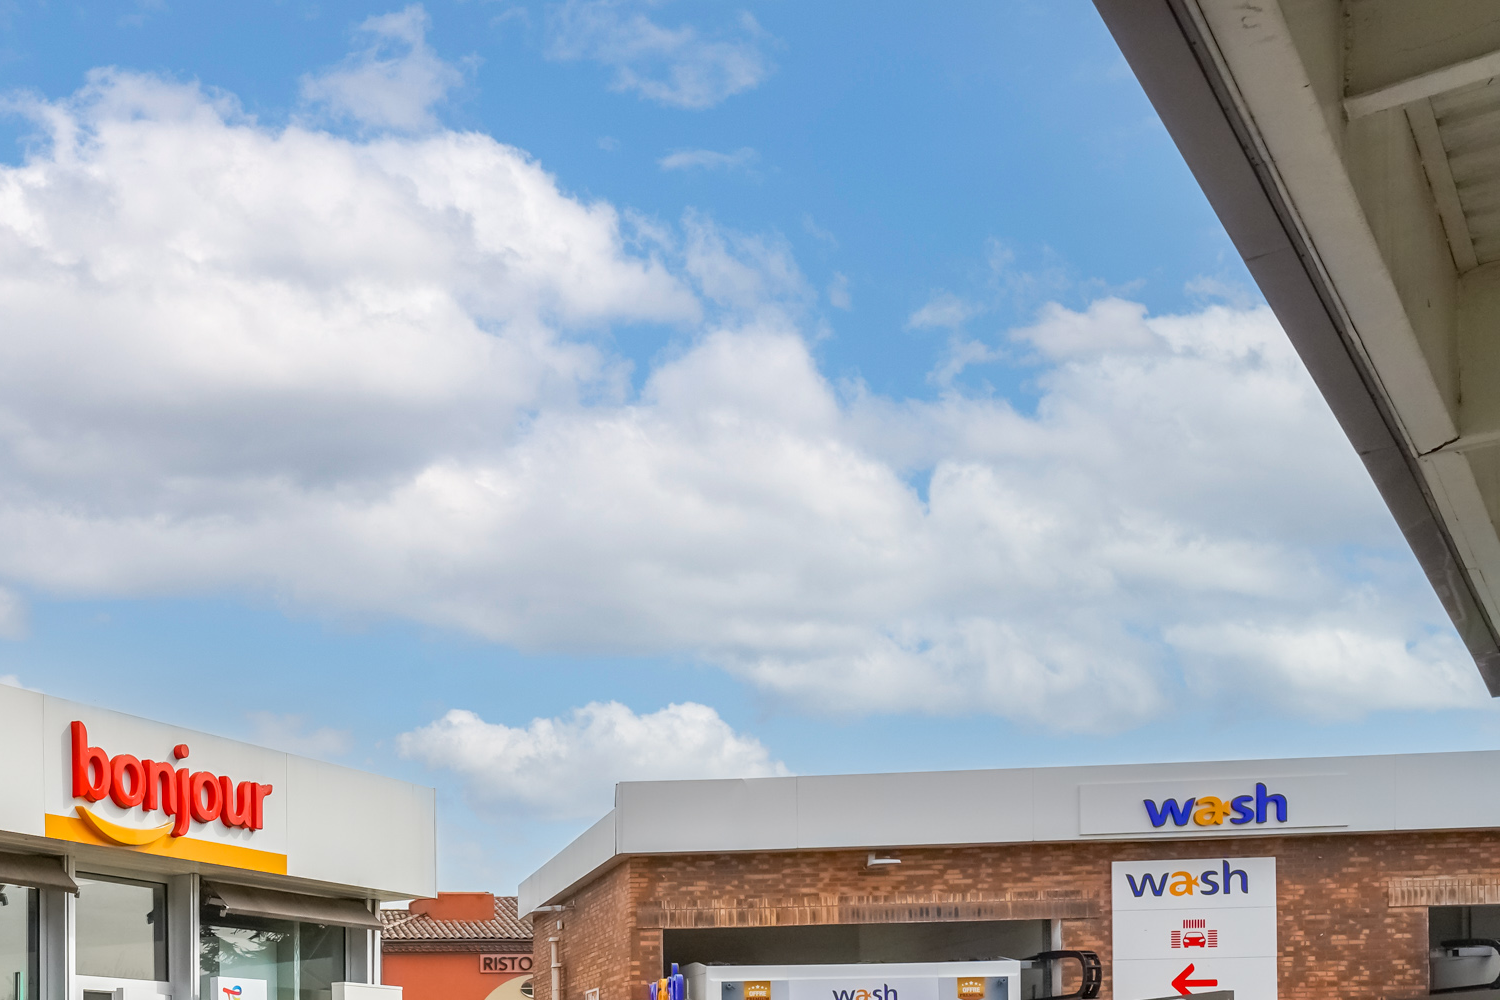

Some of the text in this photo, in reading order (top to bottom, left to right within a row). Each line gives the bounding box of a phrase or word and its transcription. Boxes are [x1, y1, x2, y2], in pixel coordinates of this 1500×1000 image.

[71, 720, 273, 838] bonjour
[1143, 782, 1288, 827] wash
[1125, 860, 1248, 897] wash
[483, 956, 533, 971] RISTO
